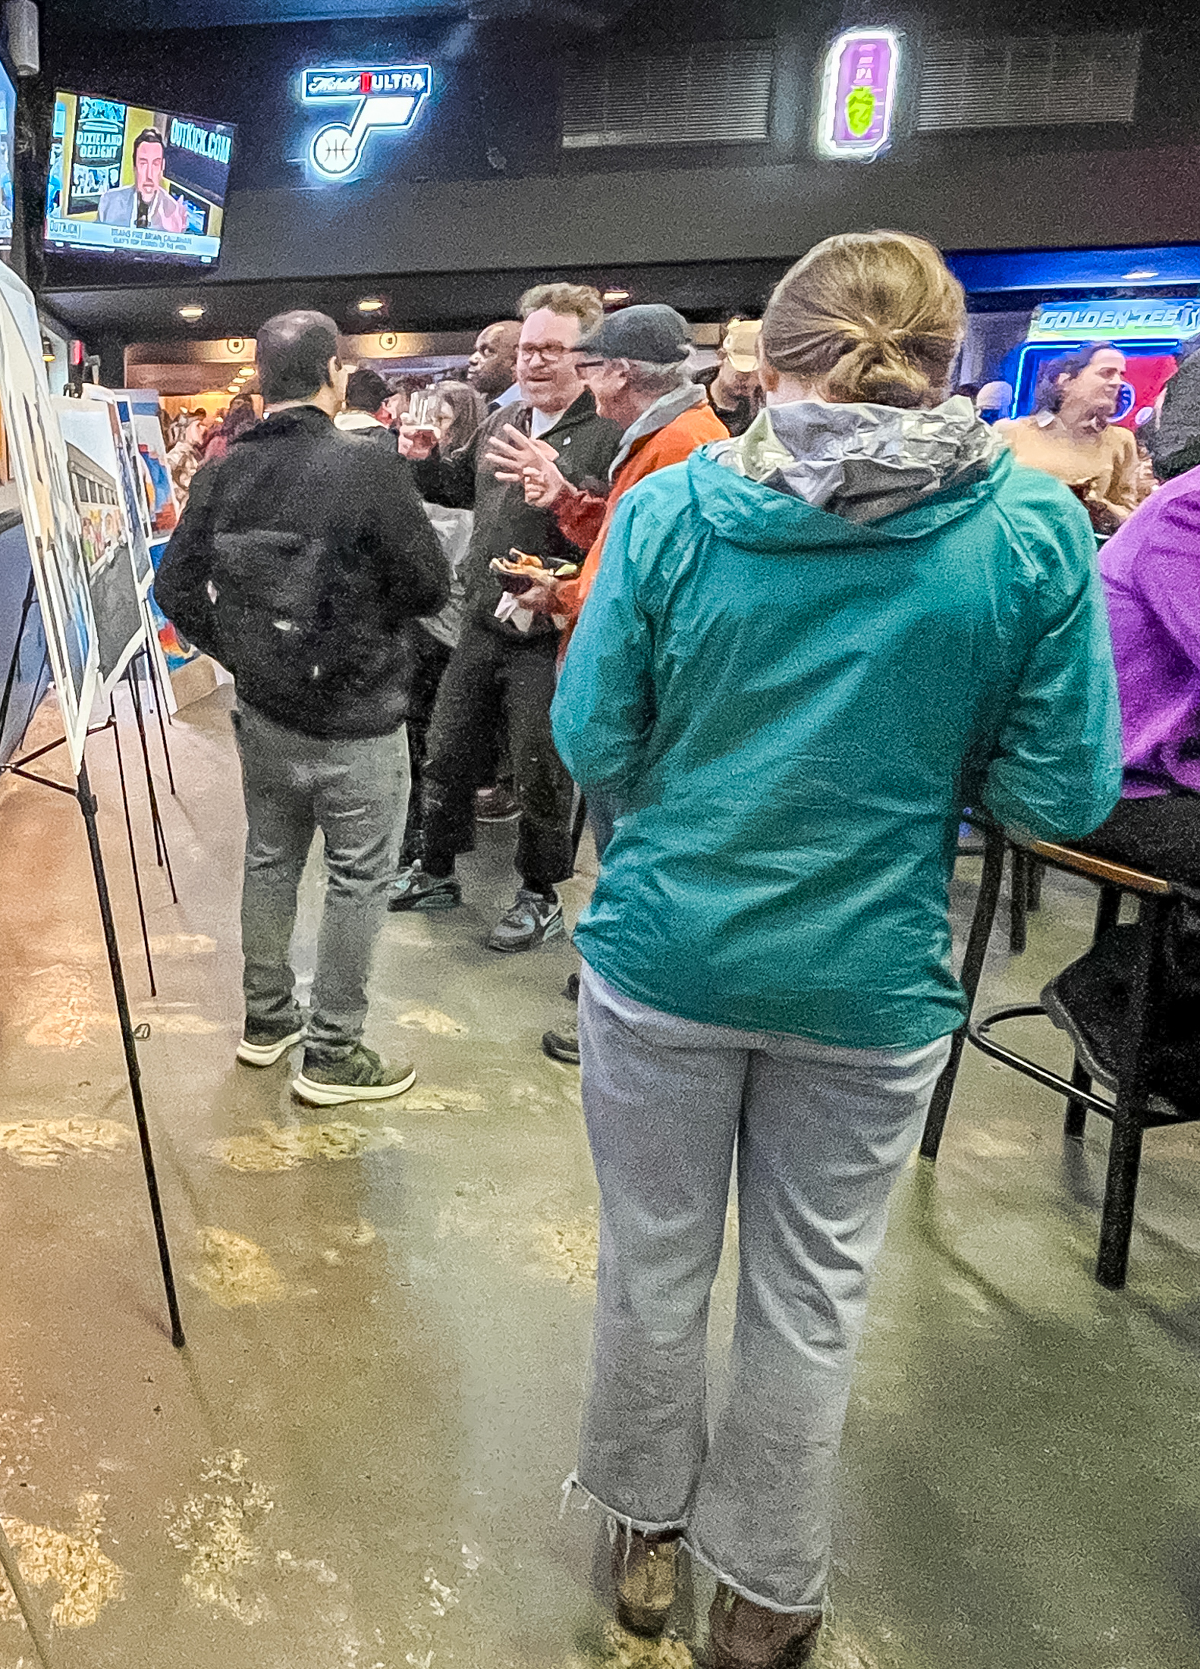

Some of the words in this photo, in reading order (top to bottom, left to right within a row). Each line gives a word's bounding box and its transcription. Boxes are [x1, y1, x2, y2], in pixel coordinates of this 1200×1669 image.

[372, 73, 426, 91] ULTRA
[76, 131, 123, 146] DIXIELAND
[80, 144, 118, 158] DELIGHT
[1039, 309, 1131, 330] GOLDEN
[1134, 308, 1179, 328] TEE
